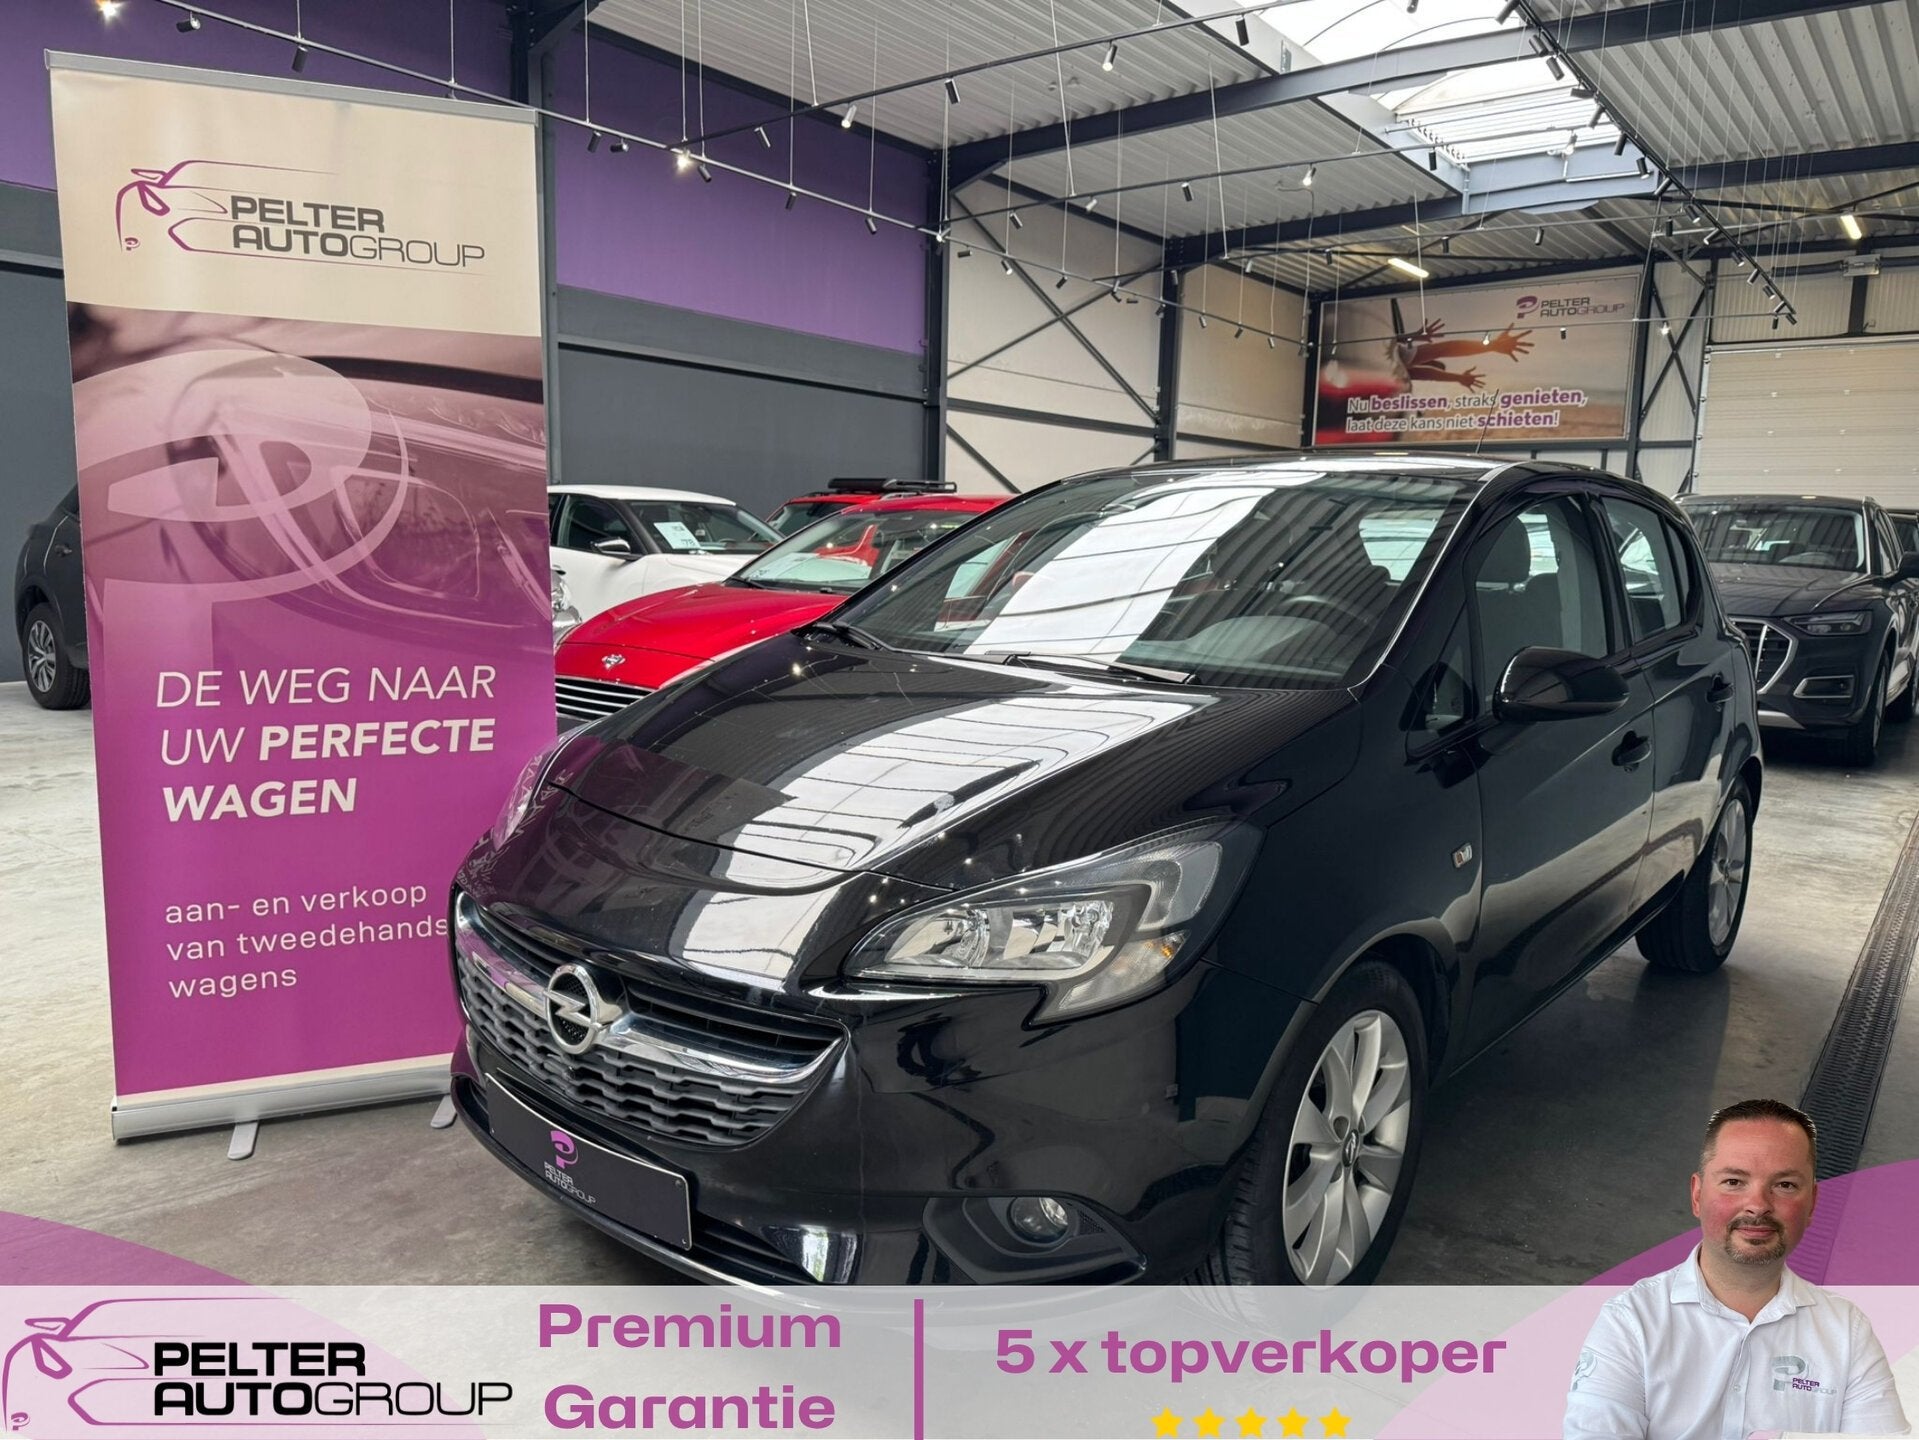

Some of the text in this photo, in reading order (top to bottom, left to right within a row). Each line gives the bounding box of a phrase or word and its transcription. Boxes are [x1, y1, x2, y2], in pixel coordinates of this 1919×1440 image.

[230, 195, 385, 233] PELTER
[233, 224, 486, 267] AUTOGROUP
[1540, 303, 1626, 318] AUTOGROUP
[1541, 297, 1591, 309] PELTER
[1349, 390, 1587, 413] Nu beslissen, straks genieten,
[1347, 411, 1559, 432] laat deze kans niet schieten!
[156, 665, 496, 708] DE WEG NAAR
[160, 718, 496, 766] UW PERFECTE
[162, 777, 357, 822] WAGEN
[165, 885, 427, 924] aan- en verkoop
[166, 914, 448, 961] van tweedehands
[168, 968, 298, 999] wagens
[544, 1161, 573, 1185] PELTER
[545, 1169, 597, 1204] AUTOGROUP
[1792, 1377, 1820, 1388] PELTER
